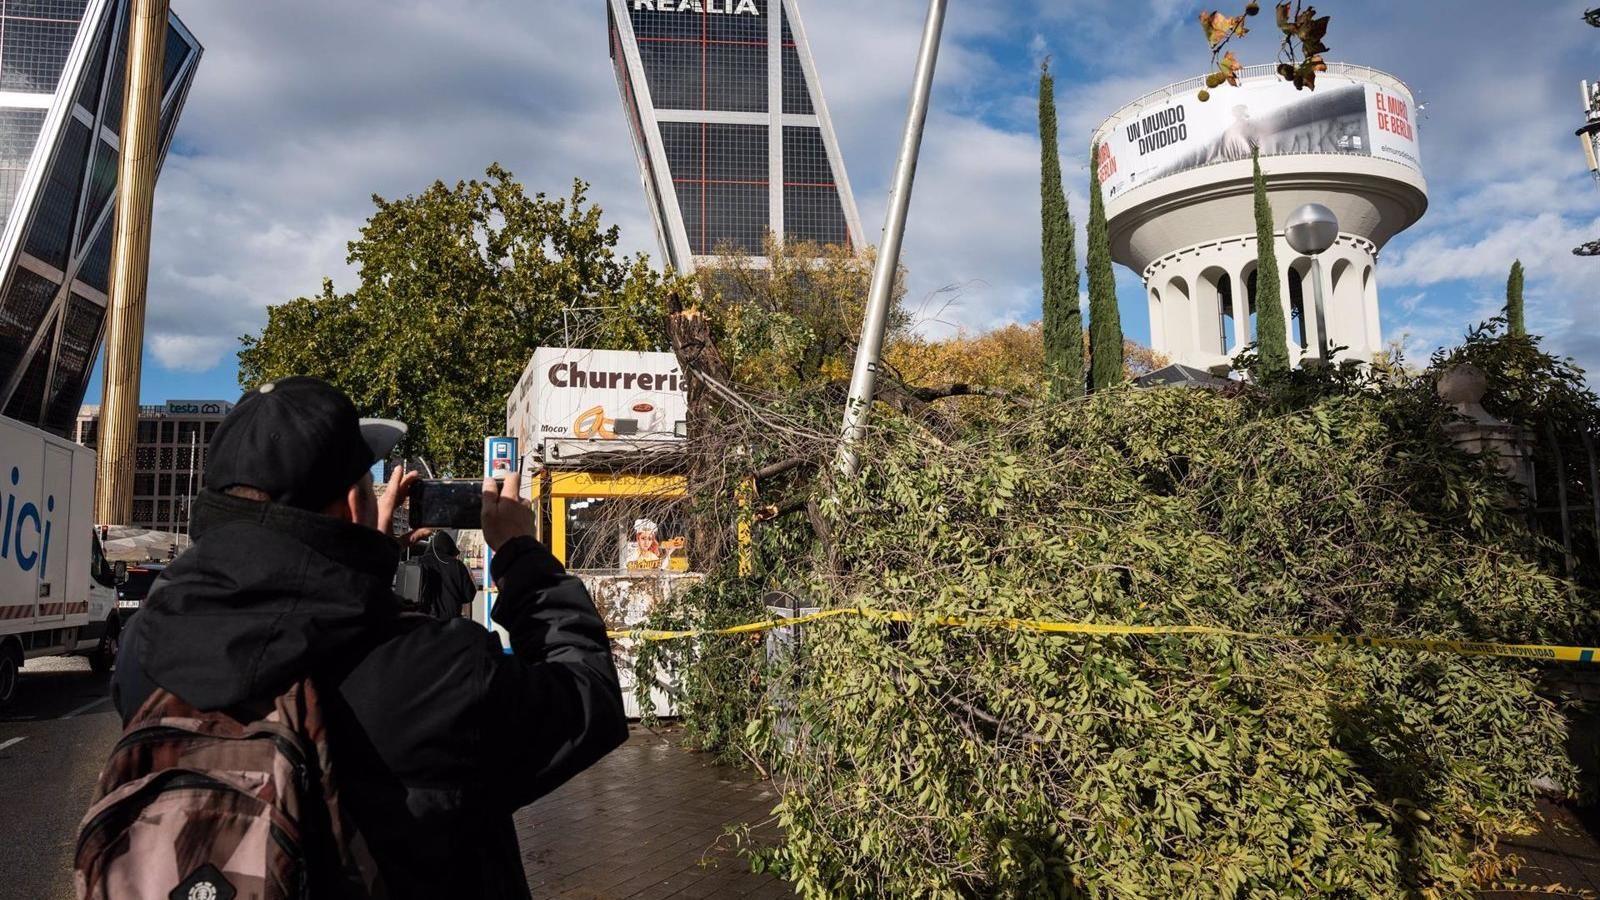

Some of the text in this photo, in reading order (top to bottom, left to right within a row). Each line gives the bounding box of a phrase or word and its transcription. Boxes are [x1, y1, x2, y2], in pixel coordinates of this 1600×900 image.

[1375, 92, 1409, 123] EL MURO
[1126, 104, 1185, 143] UN MUNDO
[1377, 112, 1413, 142] DE BERLIN
[1138, 123, 1187, 156] DIVIDIDO
[169, 403, 199, 414] testa
[541, 424, 568, 434] Mocay
[0, 466, 54, 579] ici
[1497, 646, 1509, 654] DE
[1510, 647, 1556, 658] MOVILIDAD
